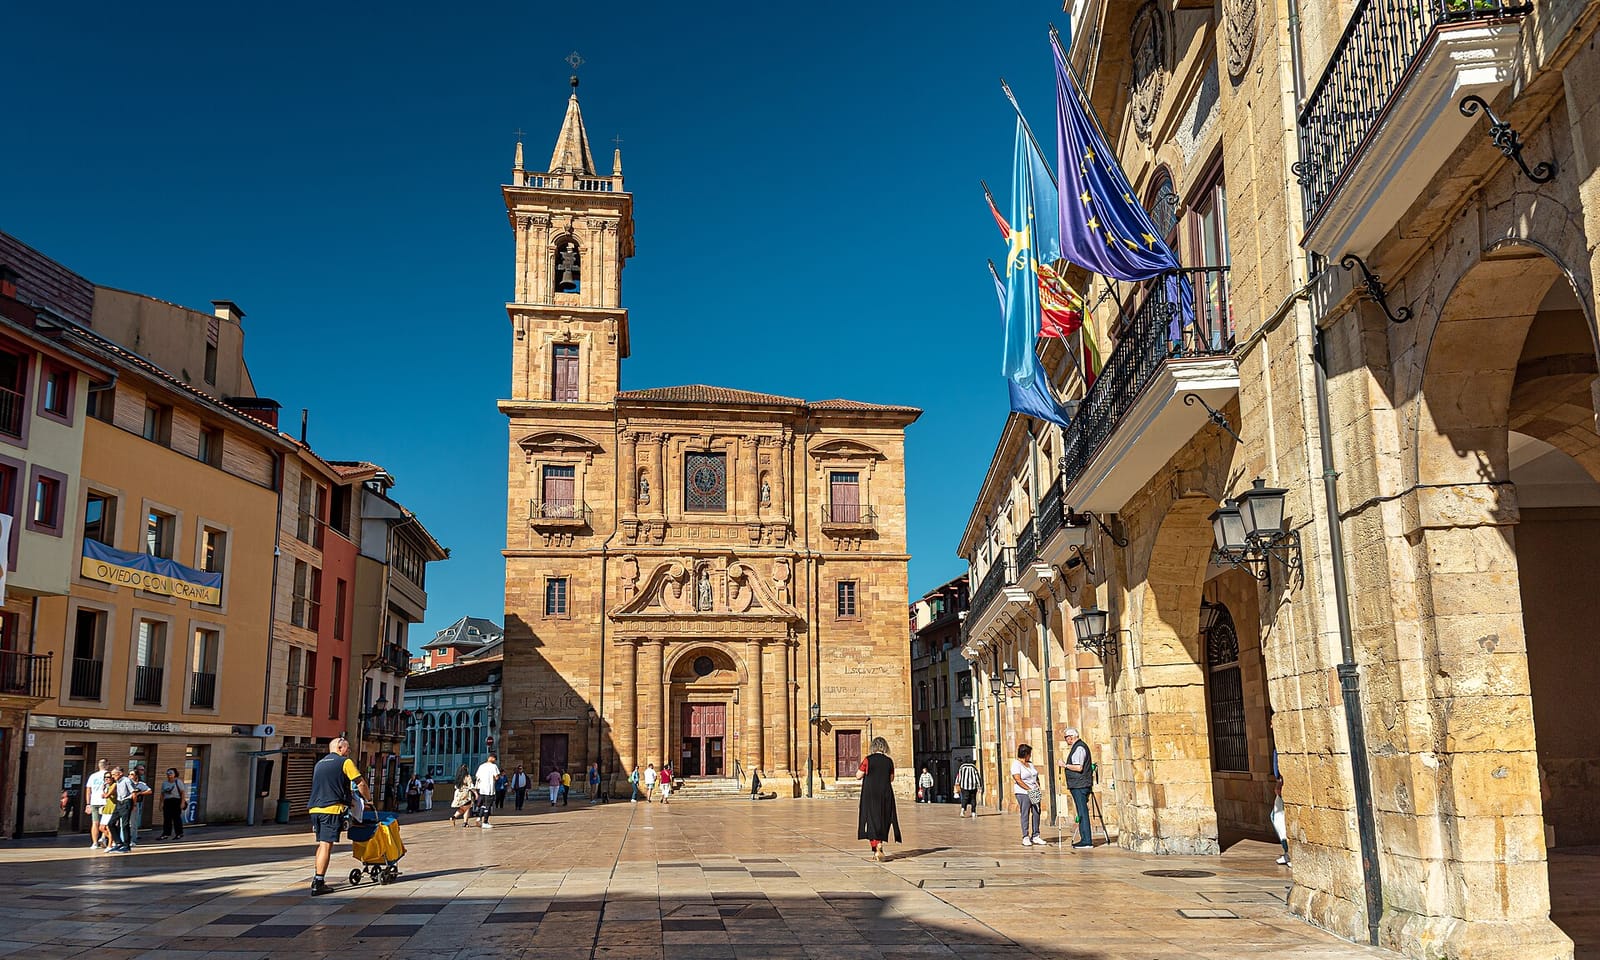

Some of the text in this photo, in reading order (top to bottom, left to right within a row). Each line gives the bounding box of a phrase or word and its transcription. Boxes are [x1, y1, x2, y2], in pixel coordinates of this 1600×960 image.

[97, 565, 141, 585] OVIEDO
[143, 575, 167, 590] CON
[58, 719, 82, 728] CENTRO
